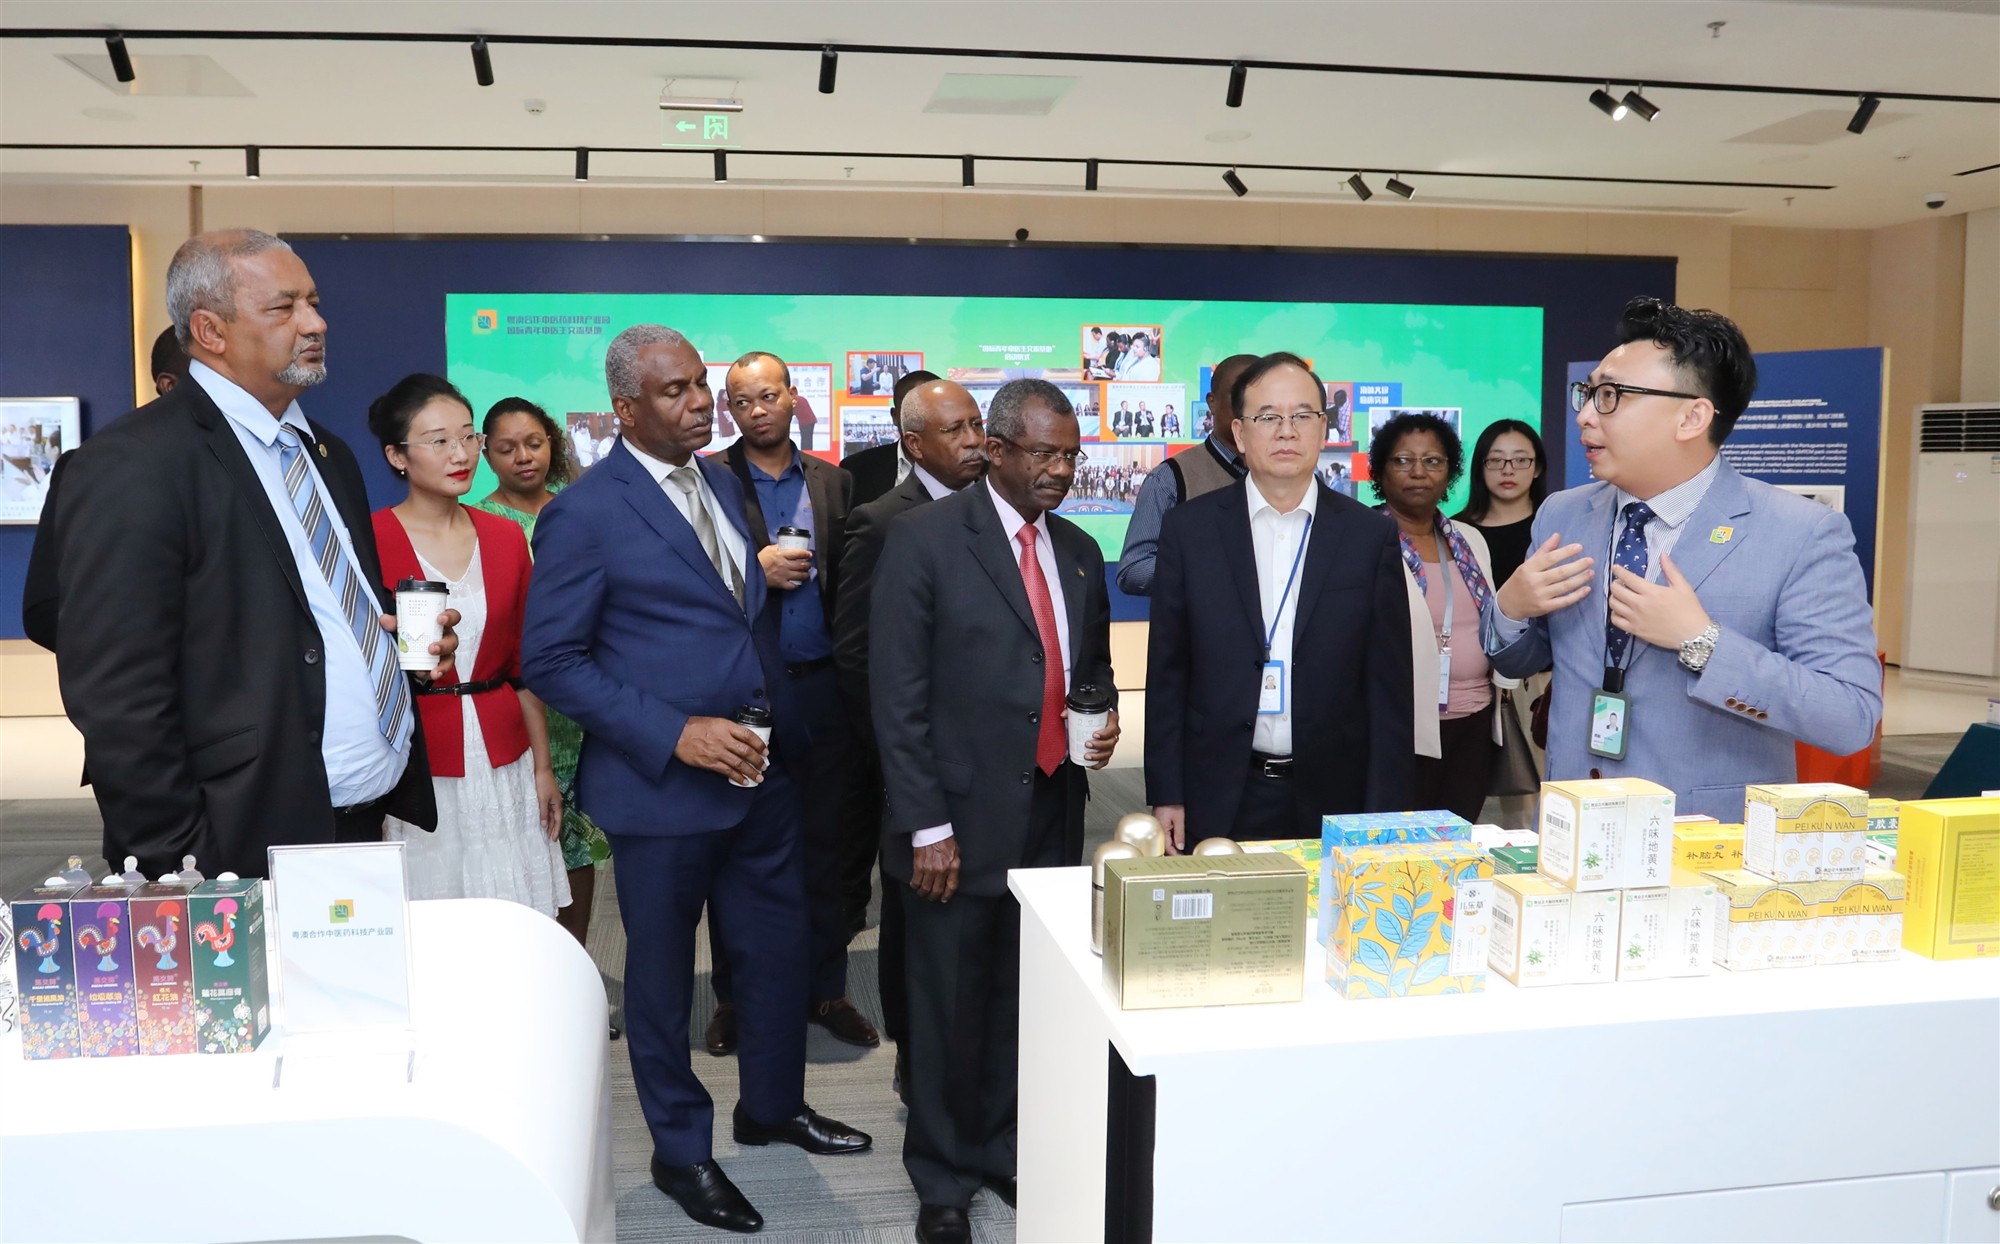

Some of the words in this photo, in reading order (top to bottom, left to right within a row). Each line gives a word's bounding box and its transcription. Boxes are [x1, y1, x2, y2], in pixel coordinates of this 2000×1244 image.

[1795, 823, 1809, 831] PEI
[1834, 822, 1856, 830] WAN
[1646, 815, 1661, 878] 六味地黄丸
[1686, 851, 1724, 860] 补脑丸
[1749, 912, 1763, 920] PEI
[1787, 910, 1808, 918] WAN
[1833, 906, 1846, 914] PEI
[1872, 905, 1893, 913] WAN
[292, 927, 394, 939] 粤澳合作中医药科技产业园
[1688, 905, 1703, 967] 六味地黄丸
[1590, 912, 1605, 975] 六味地黄丸
